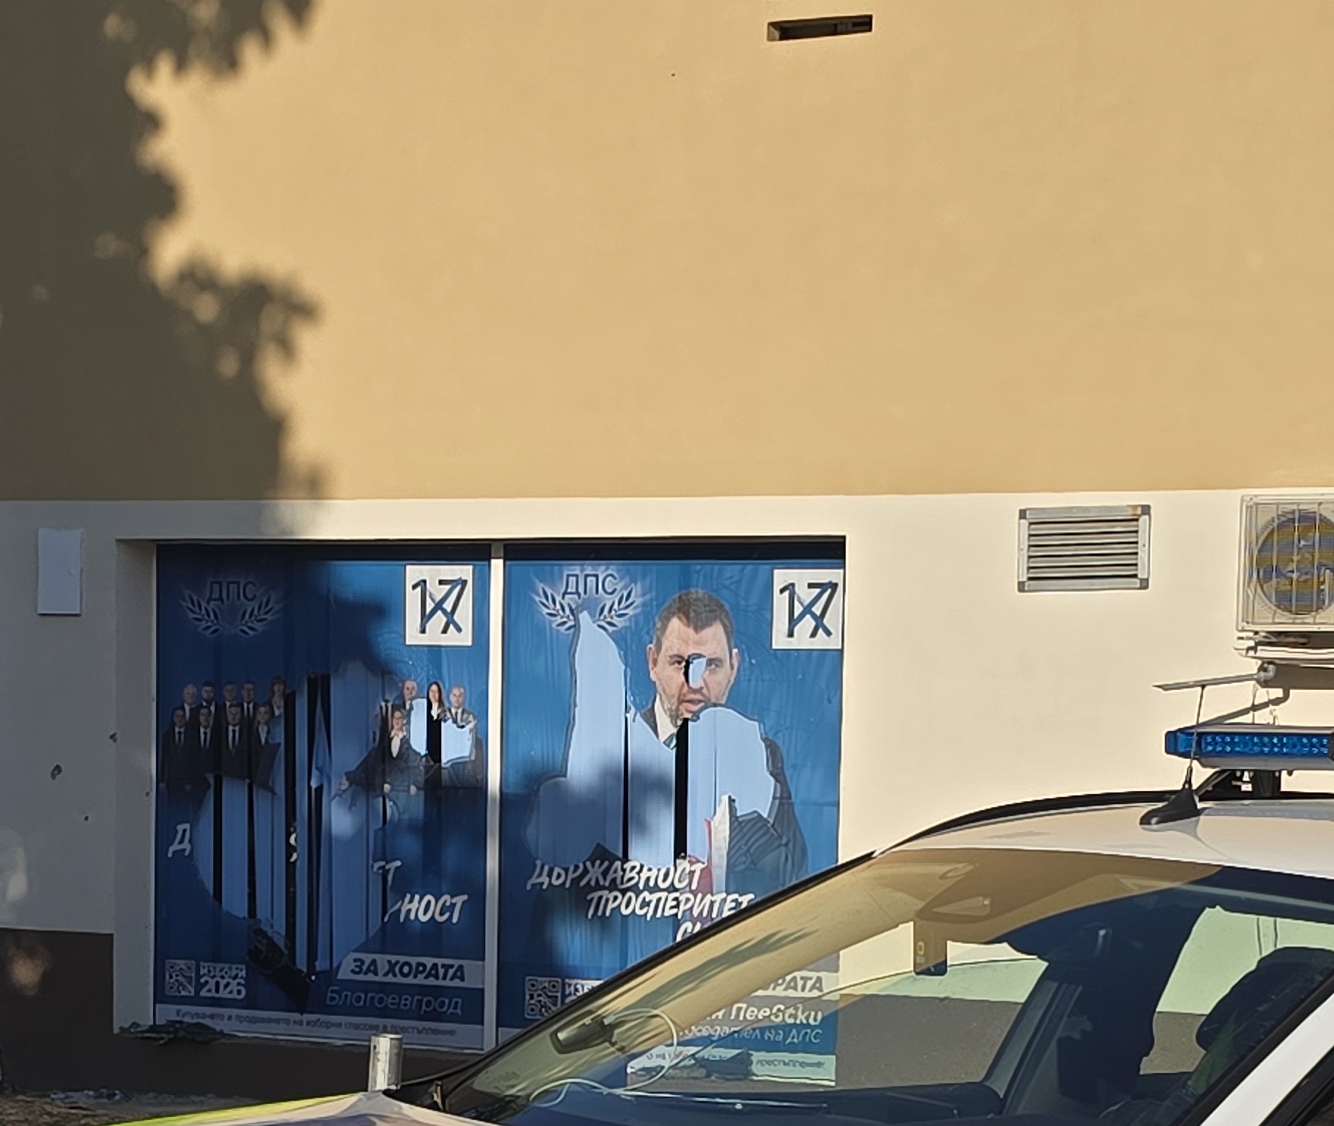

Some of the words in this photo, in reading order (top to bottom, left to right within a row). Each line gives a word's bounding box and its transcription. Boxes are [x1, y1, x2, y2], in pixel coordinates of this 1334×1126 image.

[207, 580, 258, 604] ДПС
[561, 573, 618, 600] ДПС
[350, 957, 384, 977] ЗА
[386, 959, 466, 983] ХОРАТА
[199, 976, 247, 1000] 2026
[326, 986, 463, 1016] Благоевград
[785, 1029, 823, 1045] ДПС
